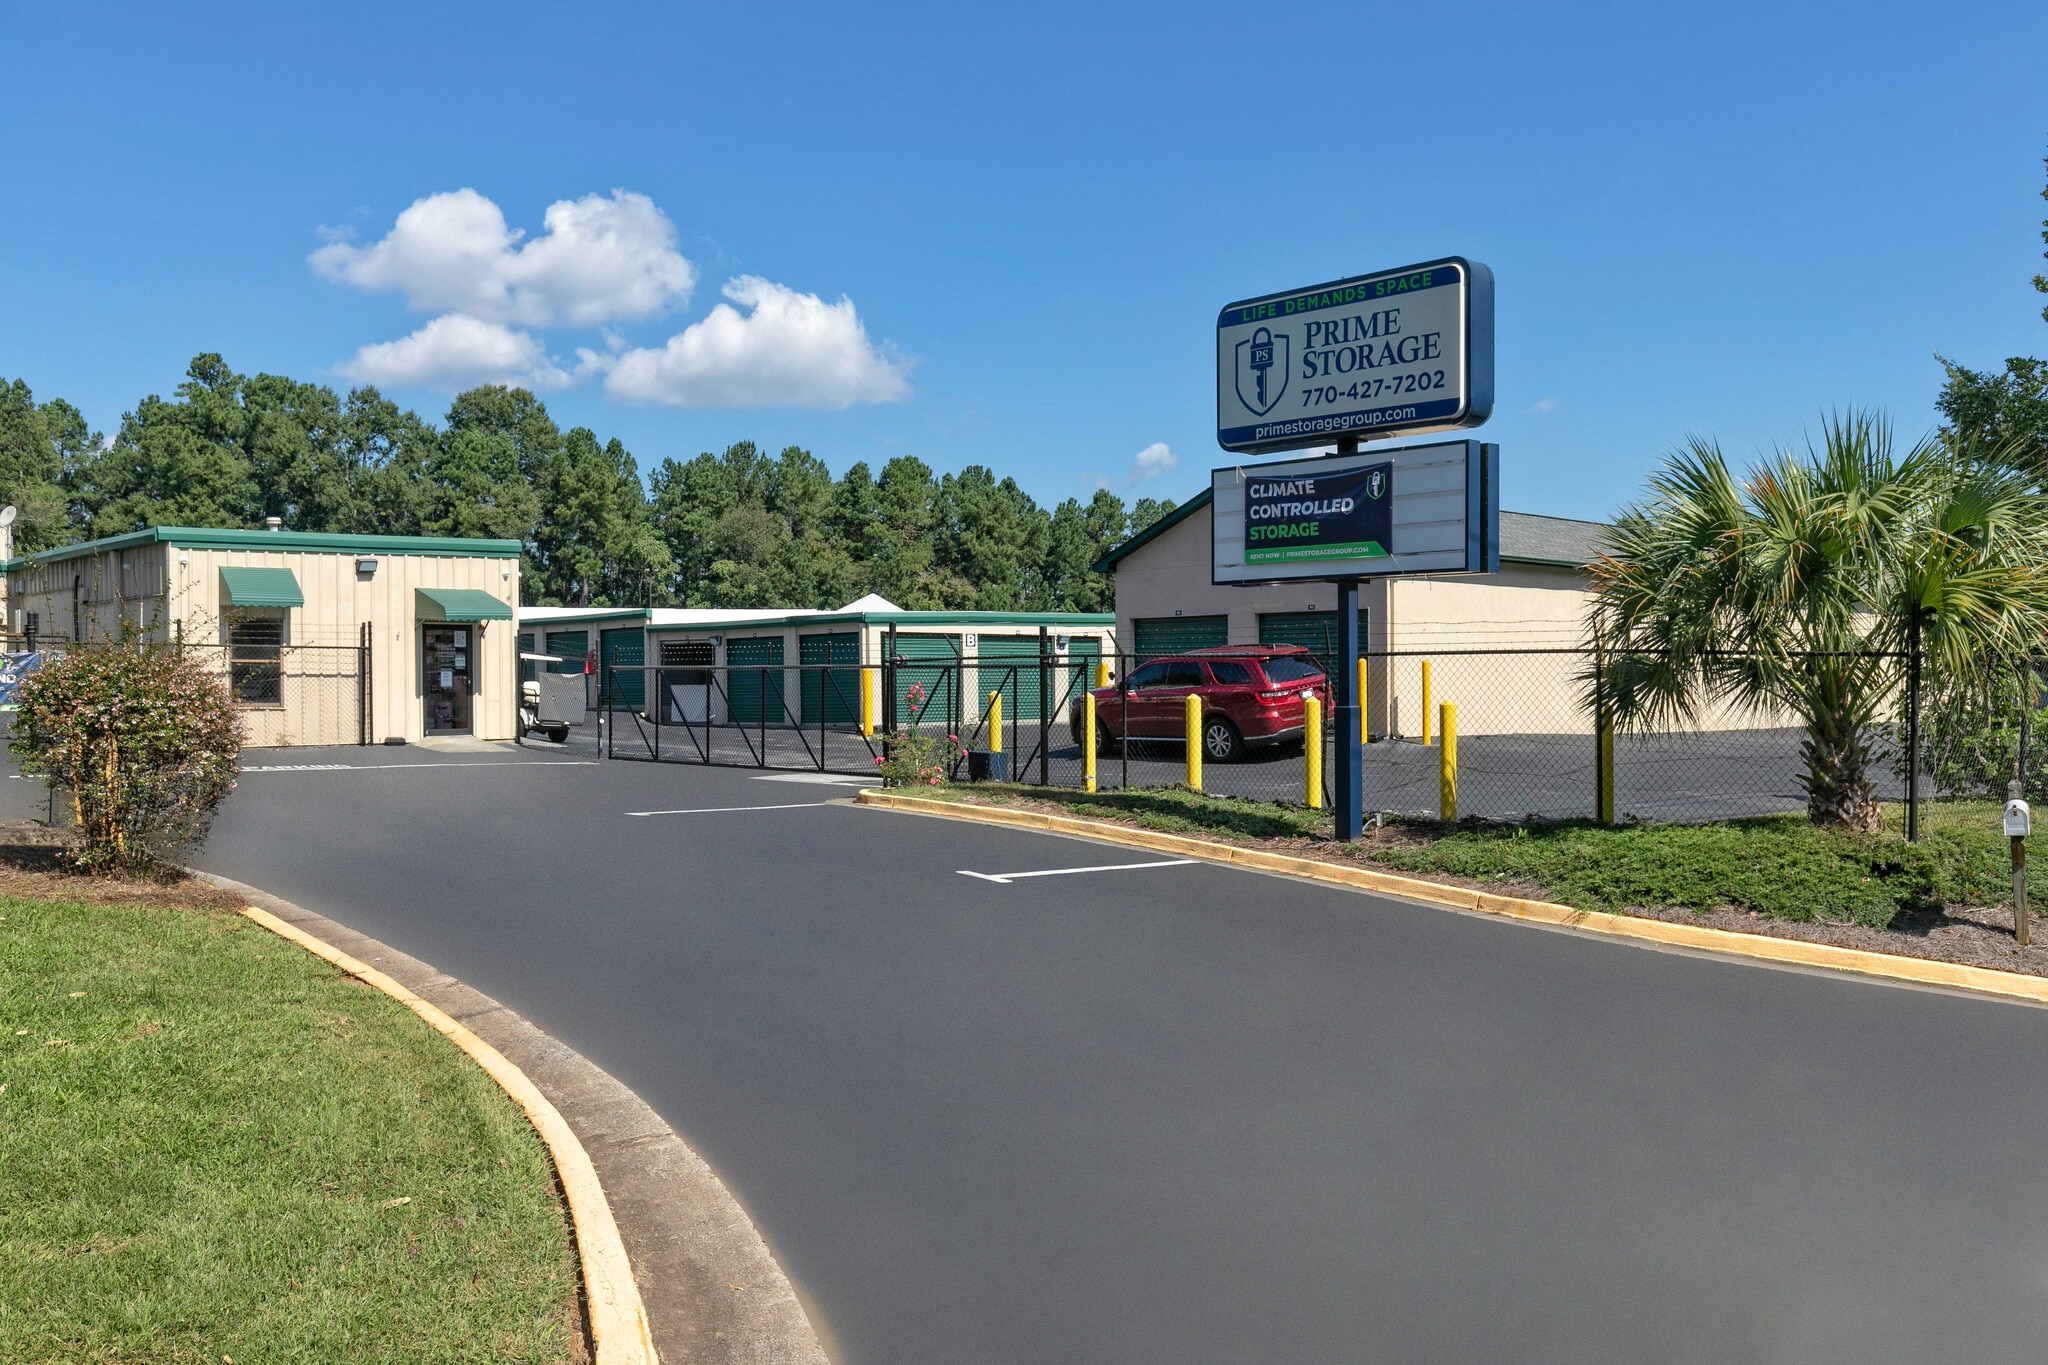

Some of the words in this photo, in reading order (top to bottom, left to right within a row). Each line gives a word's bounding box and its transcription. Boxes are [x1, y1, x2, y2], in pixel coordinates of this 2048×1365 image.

[1243, 303, 1276, 321] LIFE
[1285, 285, 1366, 313] DEMANDS
[1375, 272, 1432, 296] SPACE
[1303, 308, 1401, 350] PRIME
[1255, 349, 1269, 361] PS
[1302, 332, 1441, 379] STORAGE
[1302, 369, 1445, 407] 770-427-7202
[1255, 406, 1416, 440] primestoragegroup.com
[1249, 479, 1316, 498] CLIMATE
[1249, 498, 1354, 519] CONTROLLED
[1249, 522, 1320, 540] STORAGE
[1286, 546, 1369, 557] PRIMESTORAGEGROUP.COM
[966, 634, 976, 647] B
